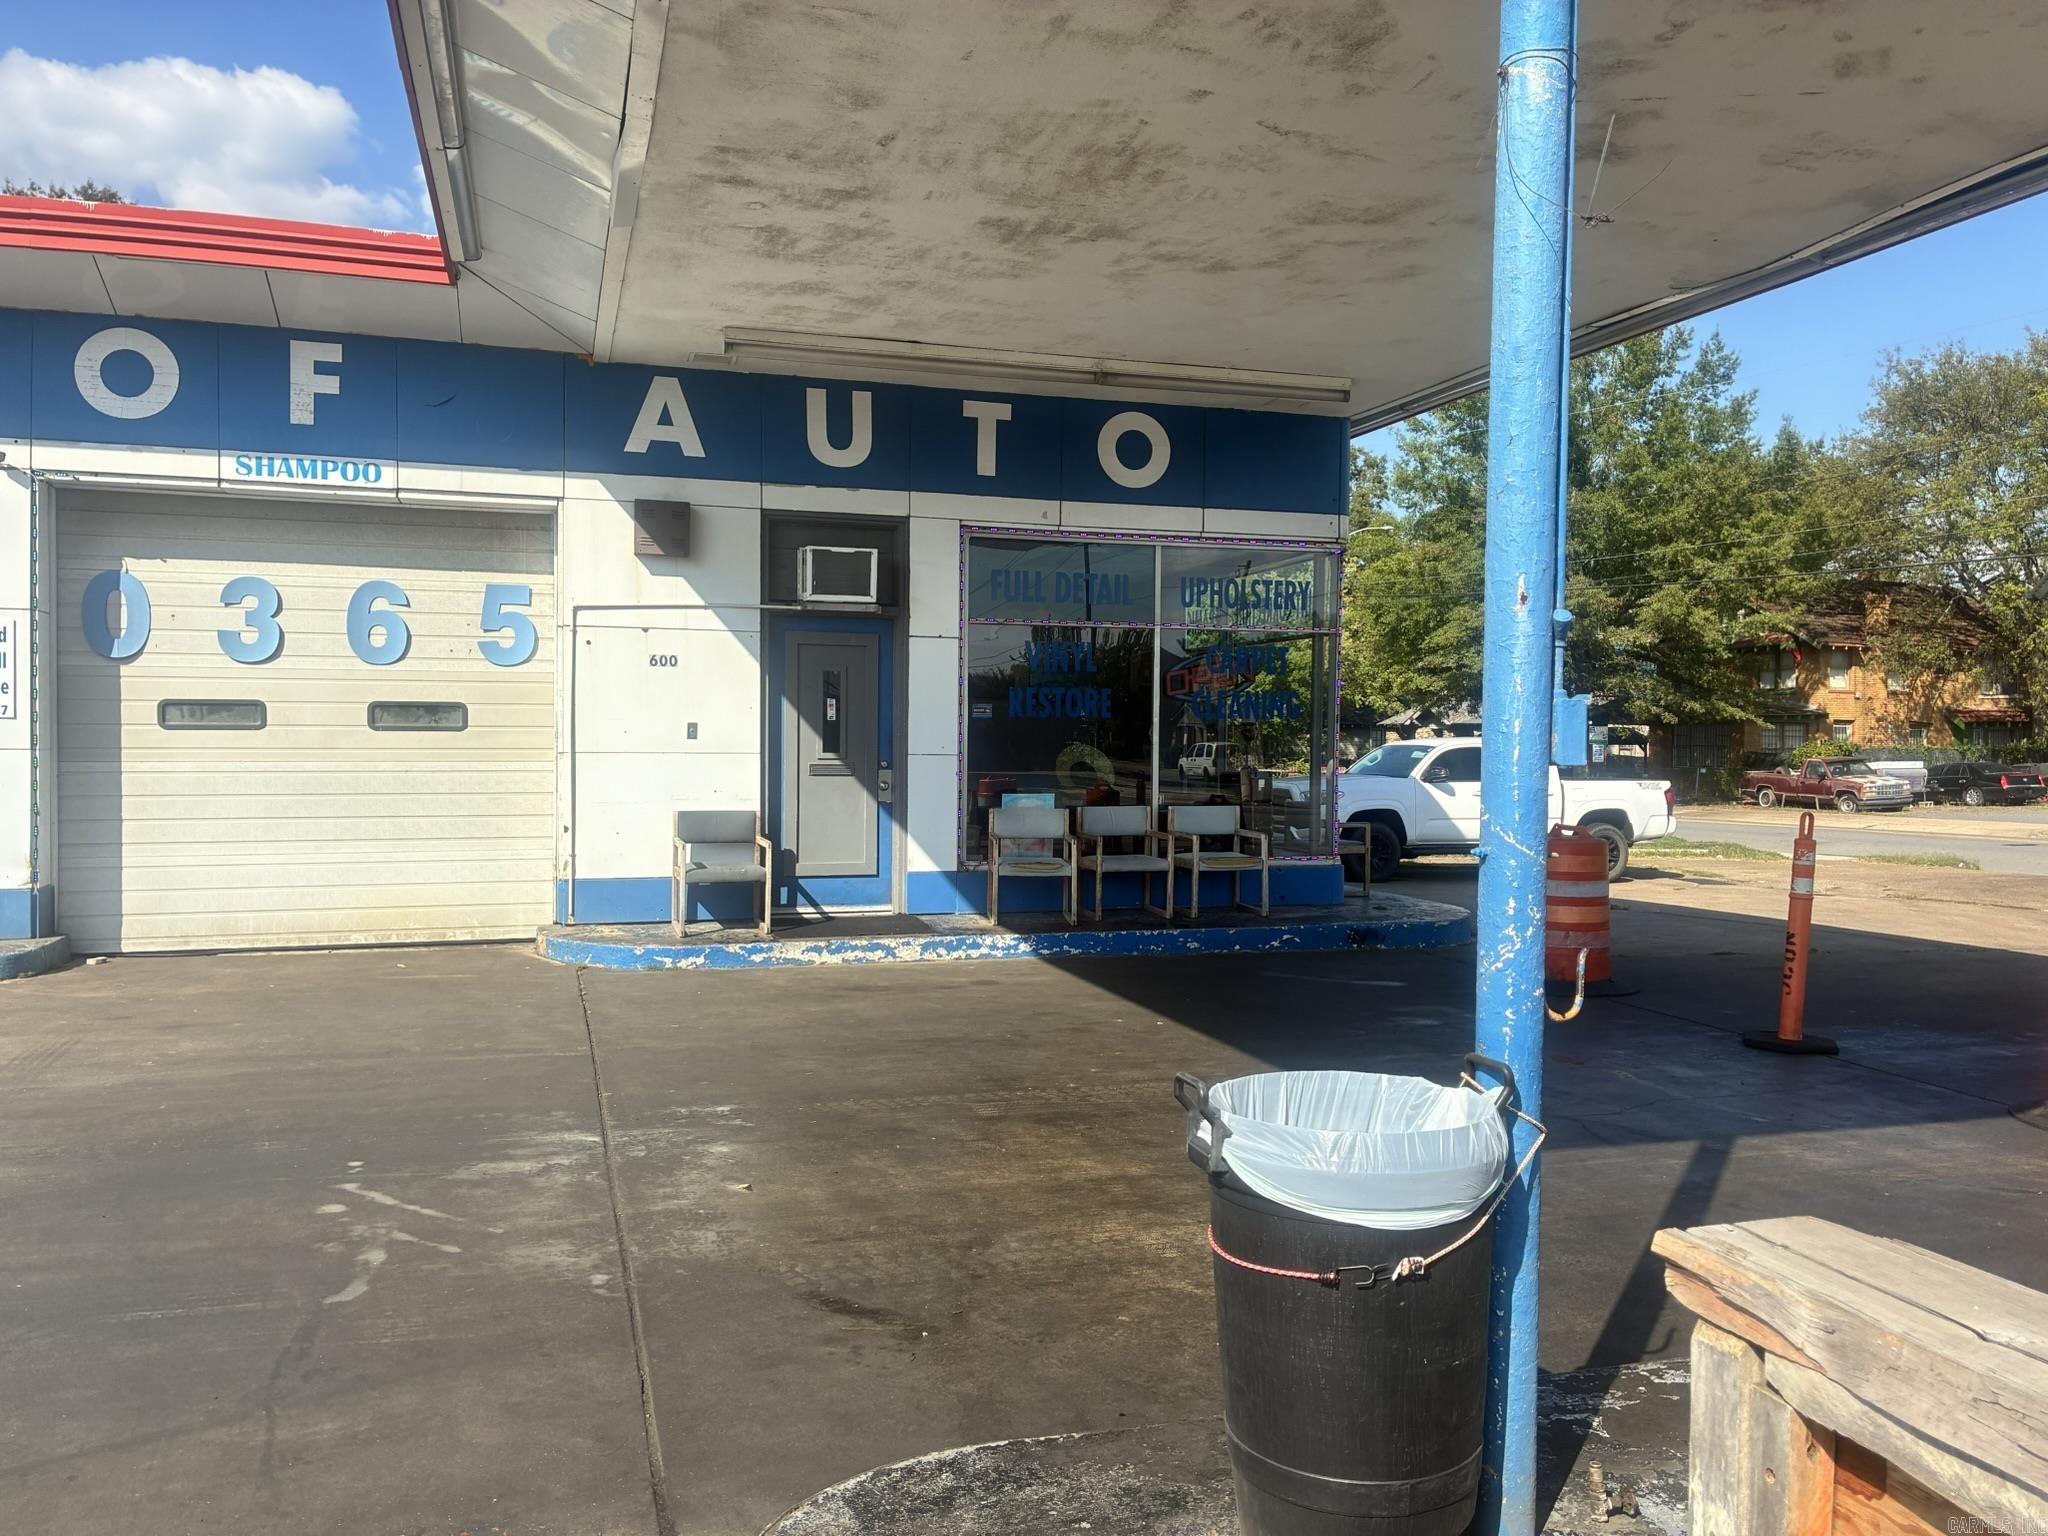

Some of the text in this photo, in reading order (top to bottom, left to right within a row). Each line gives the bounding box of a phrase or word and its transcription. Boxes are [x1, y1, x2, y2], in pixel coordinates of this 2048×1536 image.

[74, 327, 1172, 489] OF AUTO
[235, 454, 382, 484] SHAMPOO
[991, 568, 1133, 606] FULL DETAIL
[1180, 575, 1312, 611] UPHOLSTERY
[649, 654, 678, 667] 600
[1025, 639, 1098, 673] VINYL
[1206, 643, 1290, 677] CARPET
[1009, 686, 1112, 720] RESTORE
[1190, 690, 1303, 722] CLEANING
